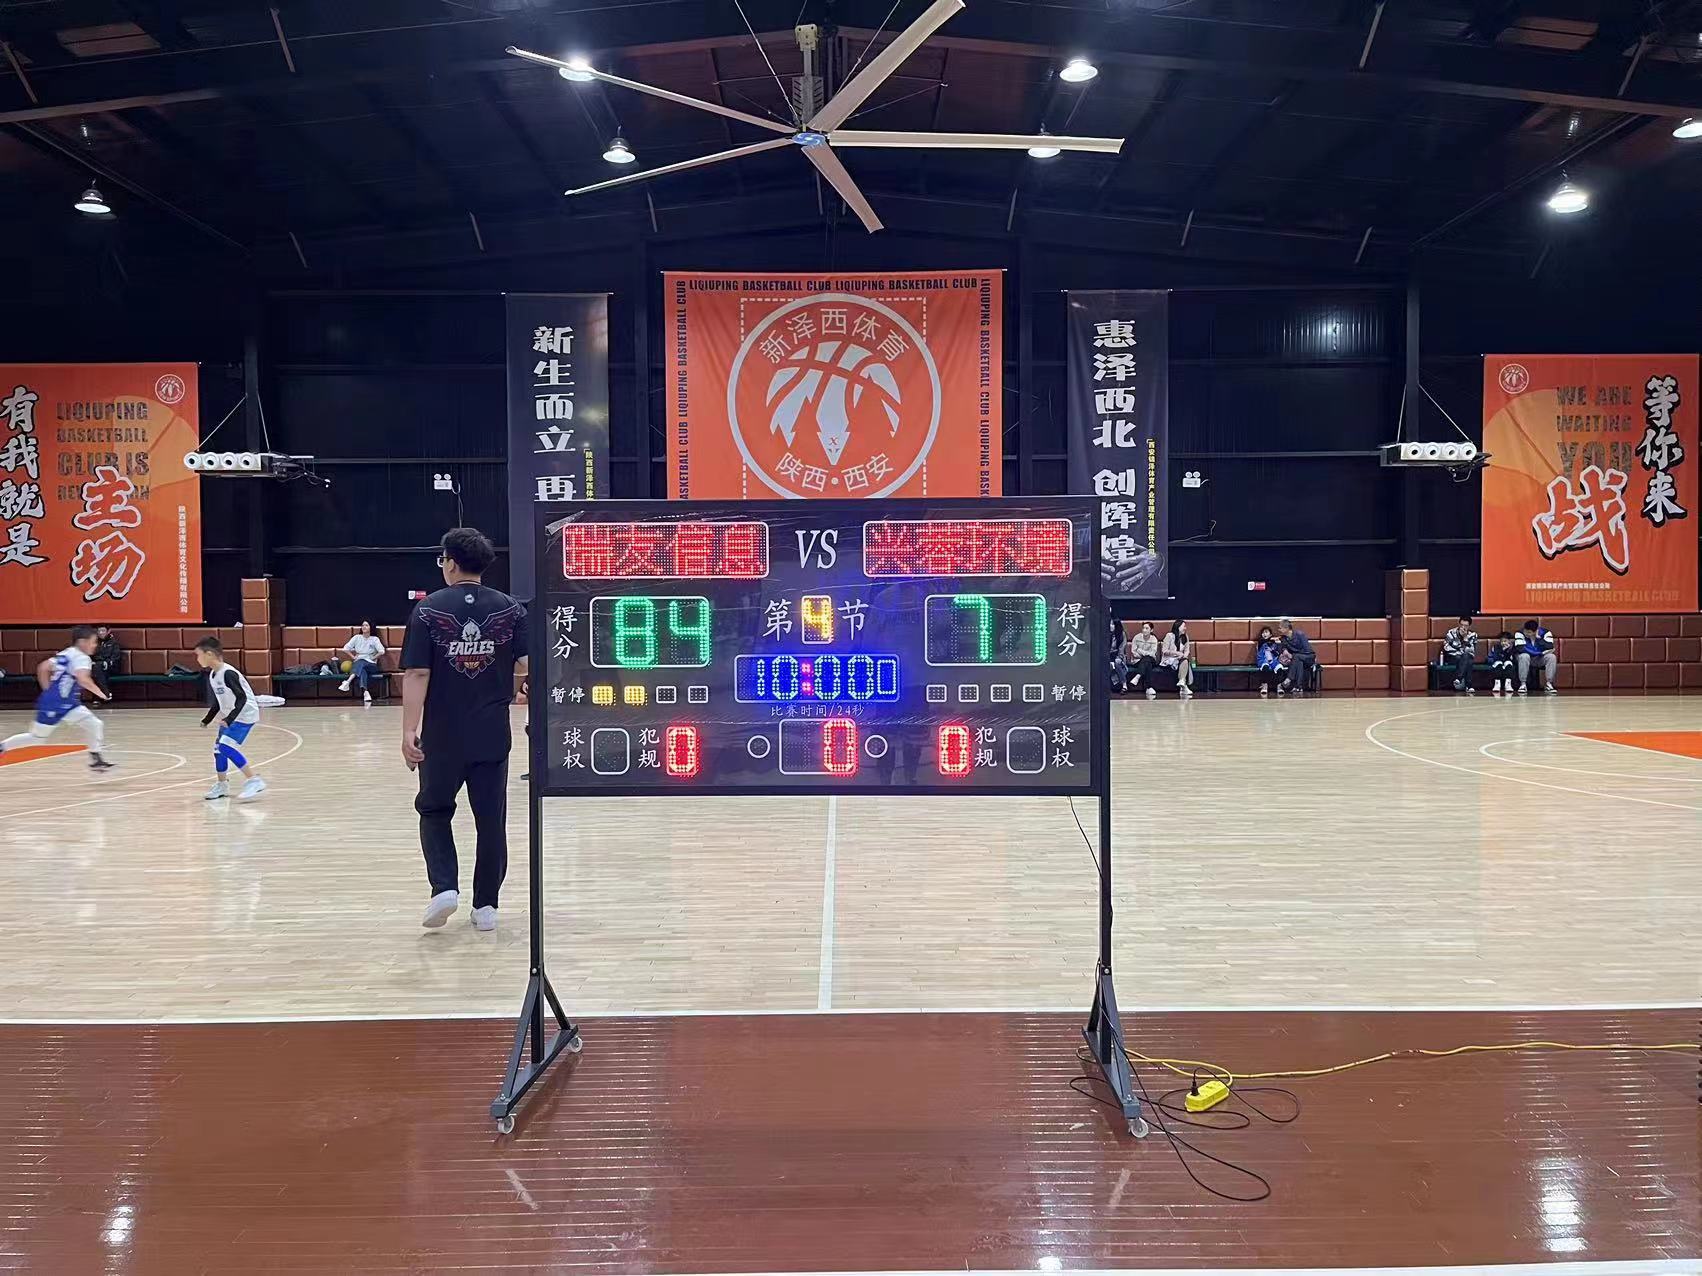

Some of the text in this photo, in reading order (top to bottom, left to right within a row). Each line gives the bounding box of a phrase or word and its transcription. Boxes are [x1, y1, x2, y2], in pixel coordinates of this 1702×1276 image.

[689, 278, 977, 291] LIQIUPING BASKETBALL CLUB LIQIUPING BASKETBALL CLUB
[759, 307, 909, 364] 新泽西体育
[533, 325, 577, 454] 新生而立
[677, 280, 688, 500] ASKETBALL CLUB LIQIUPING BASKETBALL CLUB
[980, 278, 990, 499] LIQIUPING BASKETBALL CLUB LIQIUPING BASK
[1093, 319, 1137, 449] 惠泽西北
[1557, 385, 1587, 406] WE
[56, 401, 149, 422] LIQIUPING
[1556, 415, 1632, 432] WAITING
[56, 427, 149, 443] BASKETBALL
[1635, 374, 1688, 528] 等你来
[0, 385, 49, 567] 有我就是
[125, 450, 150, 477] IS
[1532, 464, 1630, 577] 战
[794, 529, 839, 570] VS
[551, 604, 580, 660] 得分
[614, 597, 710, 667] 84
[762, 597, 869, 642] 第 4 节
[953, 594, 1047, 662] 71
[1057, 602, 1086, 657] 得分
[448, 640, 496, 656] EAGLES
[551, 686, 586, 704] 暂停
[770, 703, 865, 718] 比赛时间/24秒
[1050, 684, 1087, 702] 暂停
[562, 727, 586, 769] 球权
[638, 728, 661, 769] 犯规
[668, 727, 697, 774] 0
[823, 718, 857, 774] 0
[939, 726, 969, 774] 0
[974, 726, 998, 768] 犯规
[1051, 725, 1075, 768] 球权
